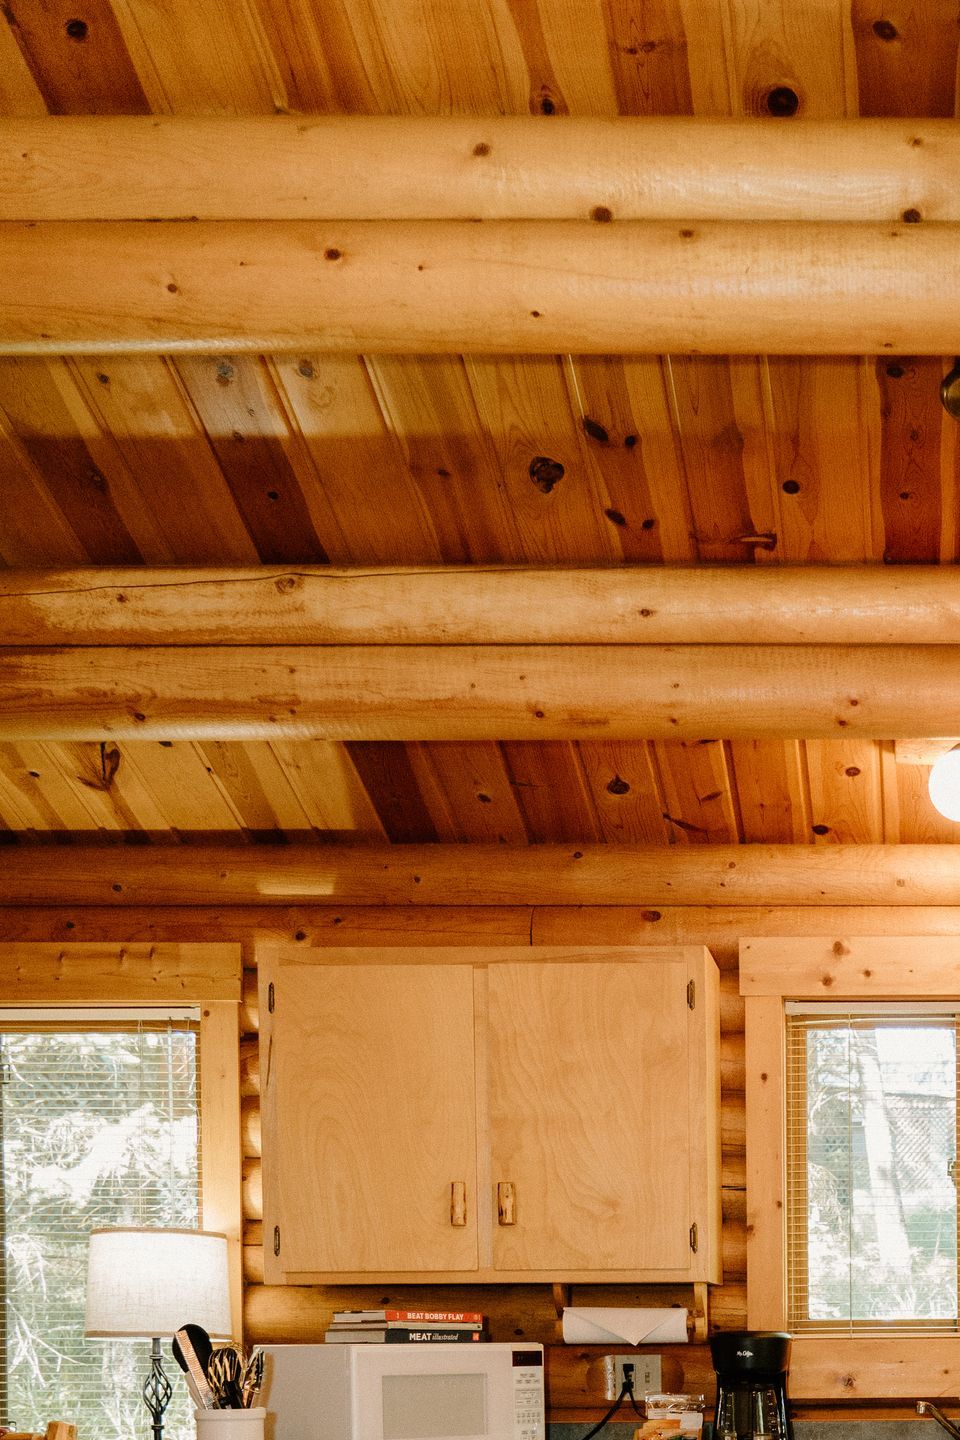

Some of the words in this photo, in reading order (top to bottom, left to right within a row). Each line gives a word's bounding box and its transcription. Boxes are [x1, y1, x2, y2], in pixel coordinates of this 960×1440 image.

[424, 1312, 447, 1320] BOBBY
[448, 1313, 464, 1321] FLAY
[409, 1332, 432, 1341] MEAT
[432, 1332, 459, 1341] illustrated
